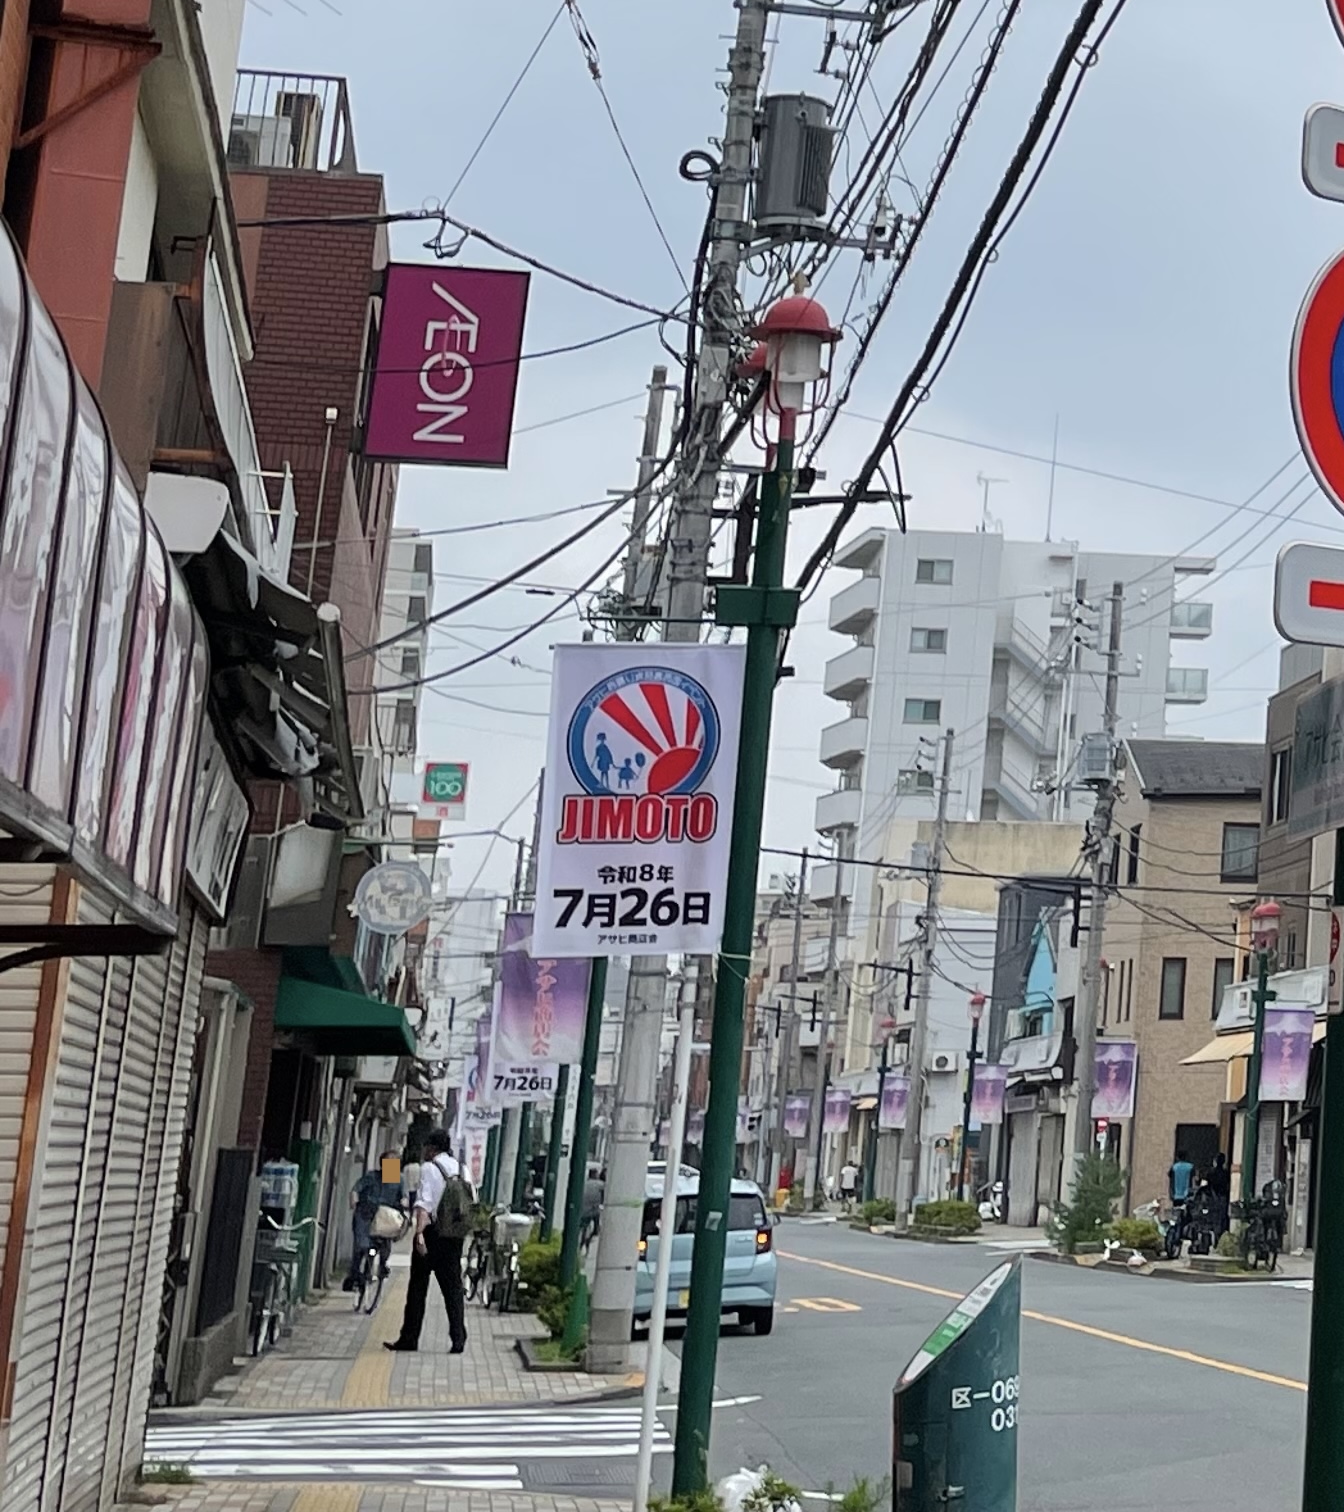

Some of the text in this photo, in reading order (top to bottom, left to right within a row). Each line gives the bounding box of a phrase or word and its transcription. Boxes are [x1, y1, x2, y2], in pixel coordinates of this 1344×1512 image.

[557, 793, 718, 844] JIMOTO
[597, 864, 674, 885] 令和8年
[553, 887, 711, 928] 7月26日
[494, 1075, 552, 1090] 7月26日
